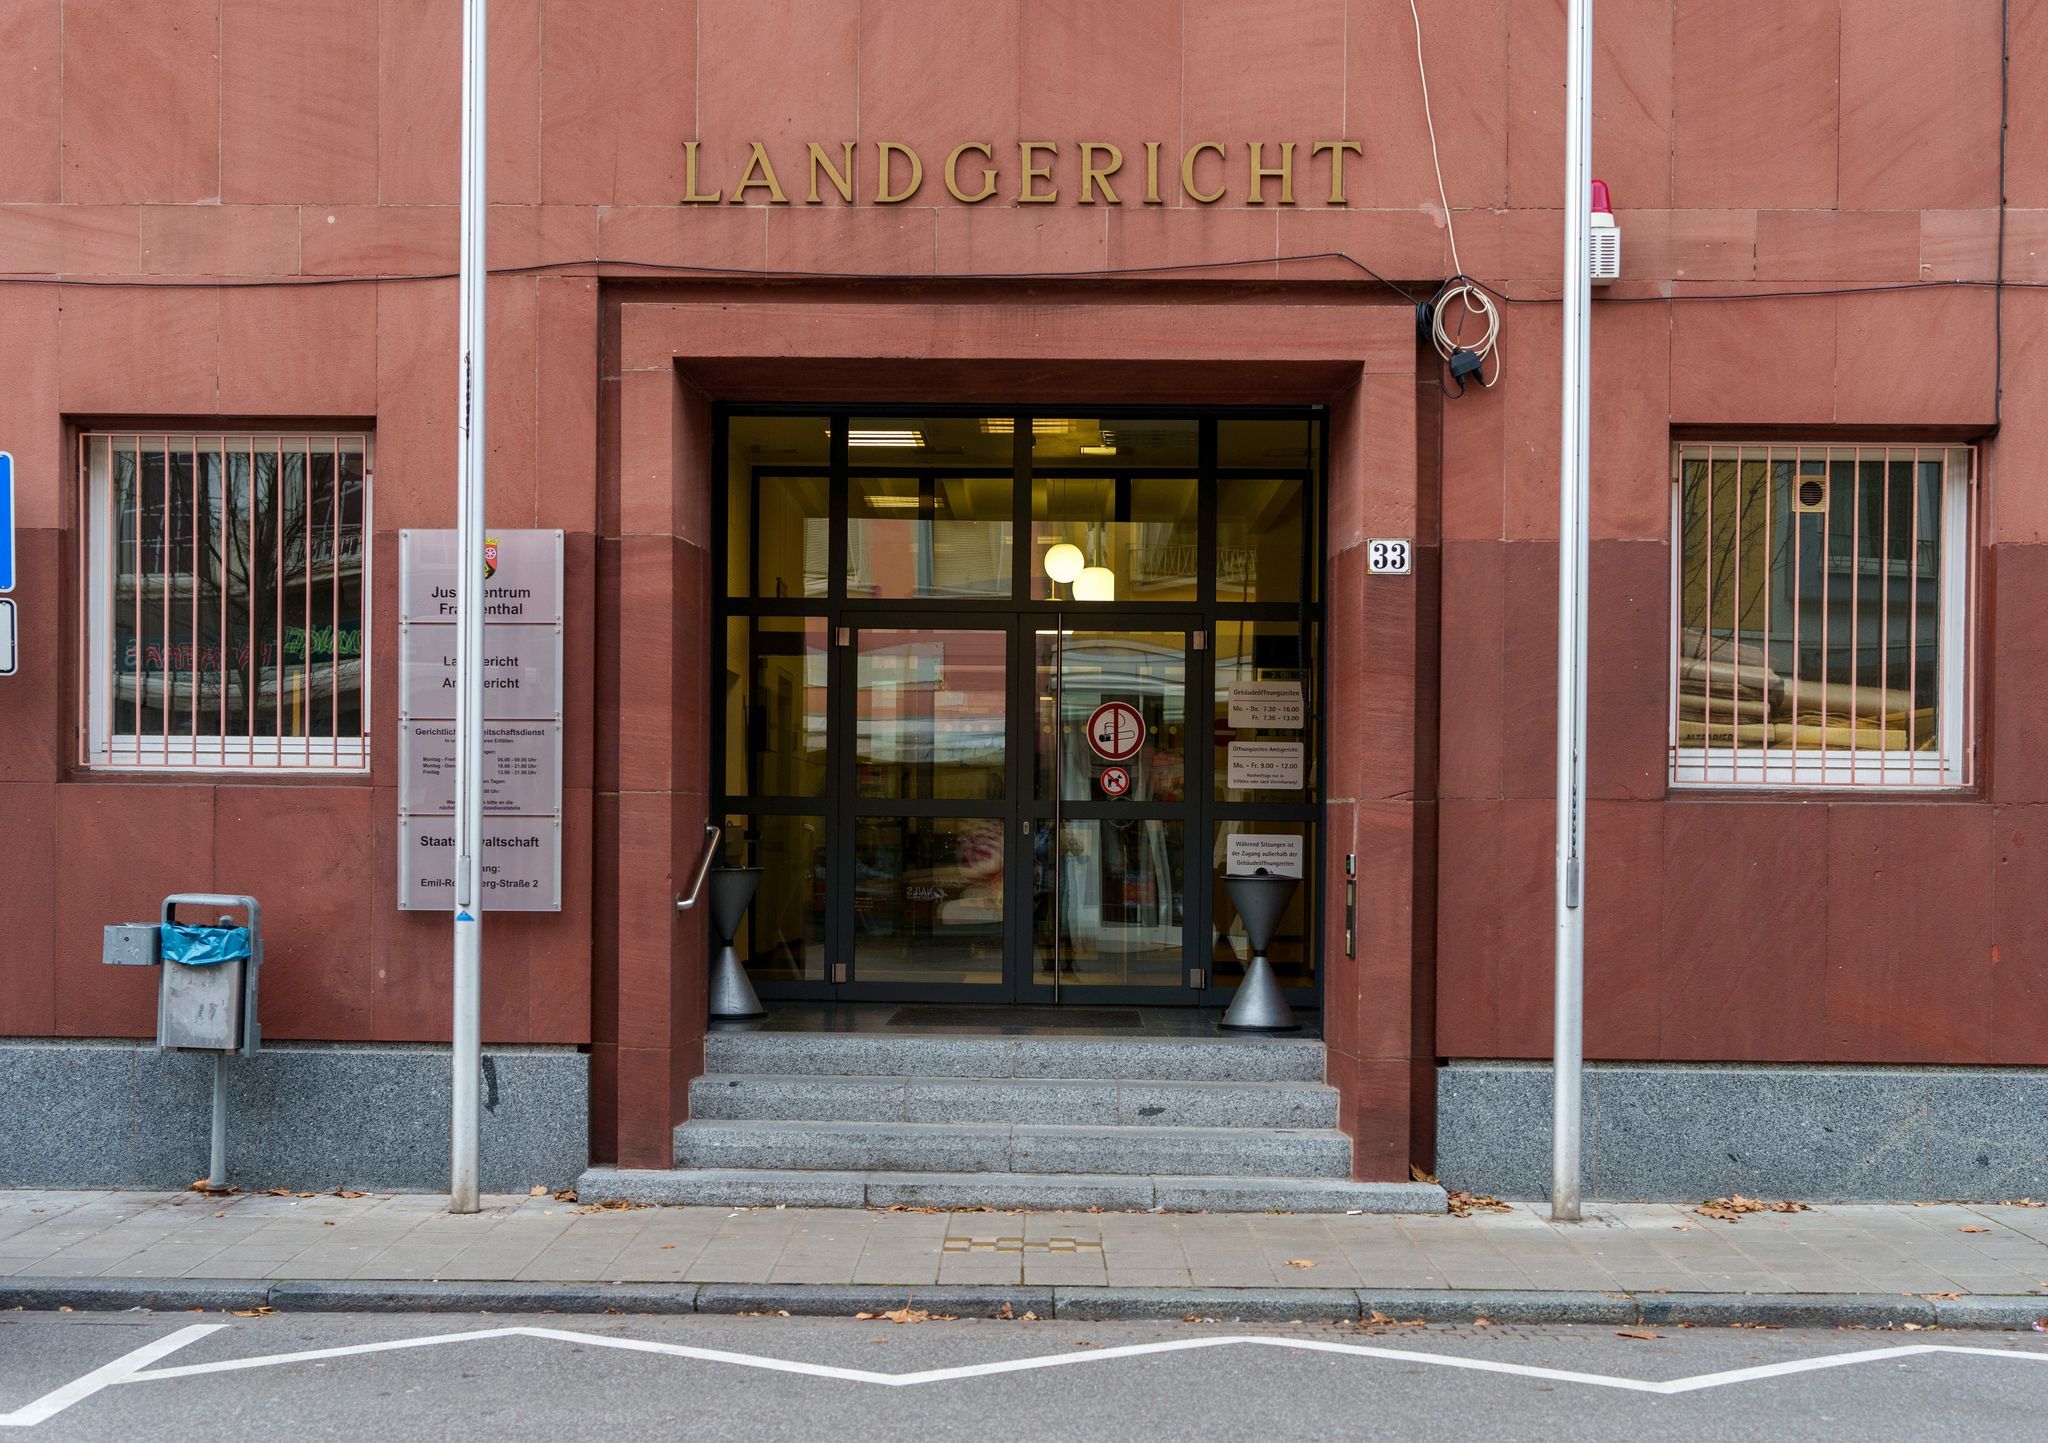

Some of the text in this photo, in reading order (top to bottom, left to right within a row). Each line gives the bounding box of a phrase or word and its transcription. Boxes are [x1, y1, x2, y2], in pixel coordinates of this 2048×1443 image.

[680, 141, 1363, 203] LANDGERICHT
[373, 543, 406, 570] 33
[431, 586, 531, 599] Jusentrum
[440, 603, 523, 615] Fraenthal
[443, 656, 519, 667] Laericht
[442, 677, 520, 689] Aericht
[483, 728, 545, 736] eitschaftsdienst
[1260, 841, 1286, 849] Sitzungen
[1242, 850, 1261, 858] Zugang
[420, 878, 539, 890] Emil-Roerg-Straße 2
